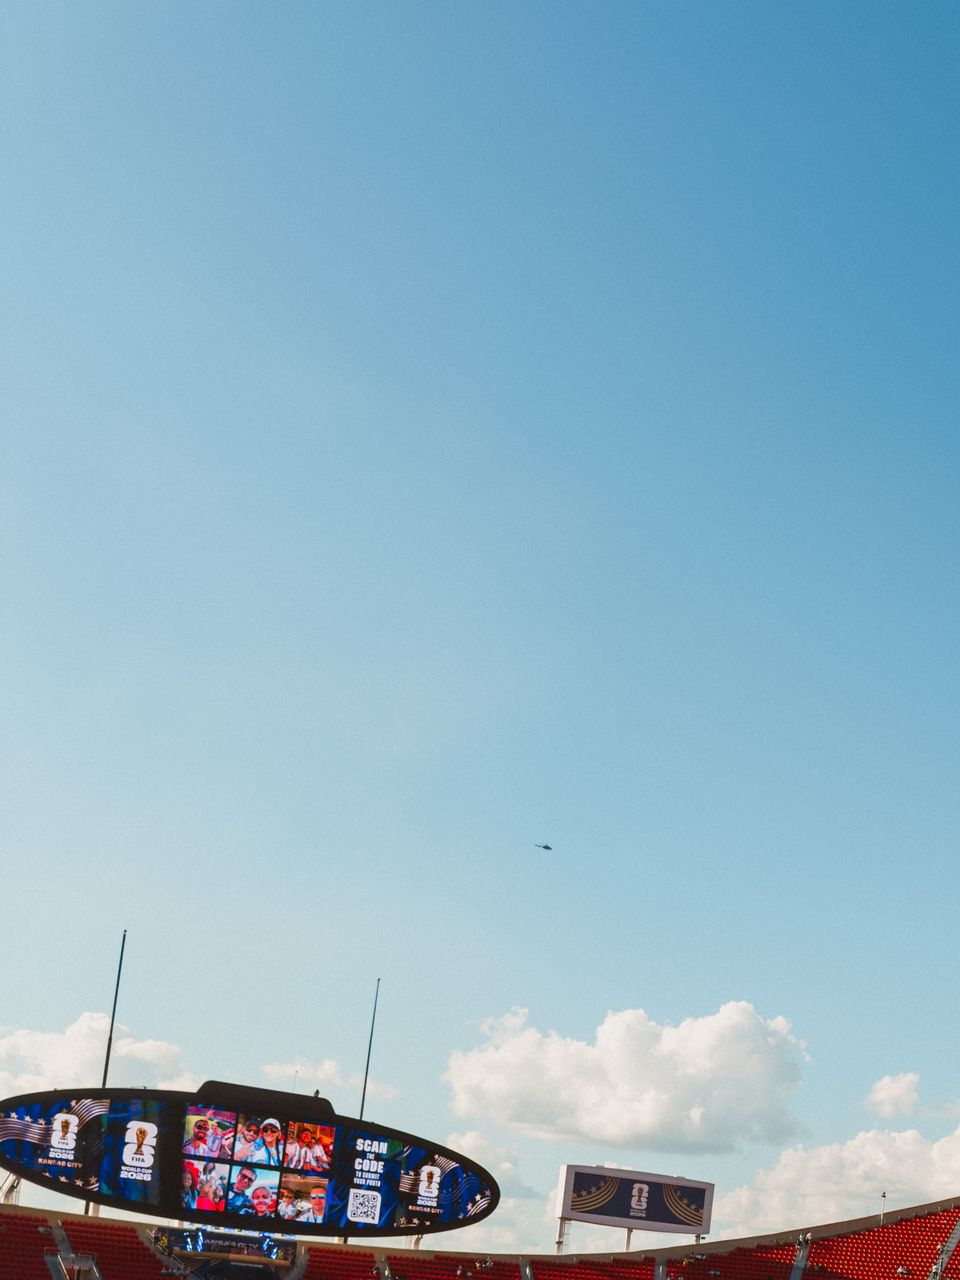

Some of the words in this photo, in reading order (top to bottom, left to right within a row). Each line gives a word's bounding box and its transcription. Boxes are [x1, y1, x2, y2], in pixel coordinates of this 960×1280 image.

[356, 1138, 388, 1154] SCAN
[49, 1152, 74, 1160] 2026
[38, 1158, 65, 1167] KANSAS
[66, 1160, 83, 1169] CITY
[354, 1158, 384, 1173] CODE
[120, 1171, 152, 1181] 2026
